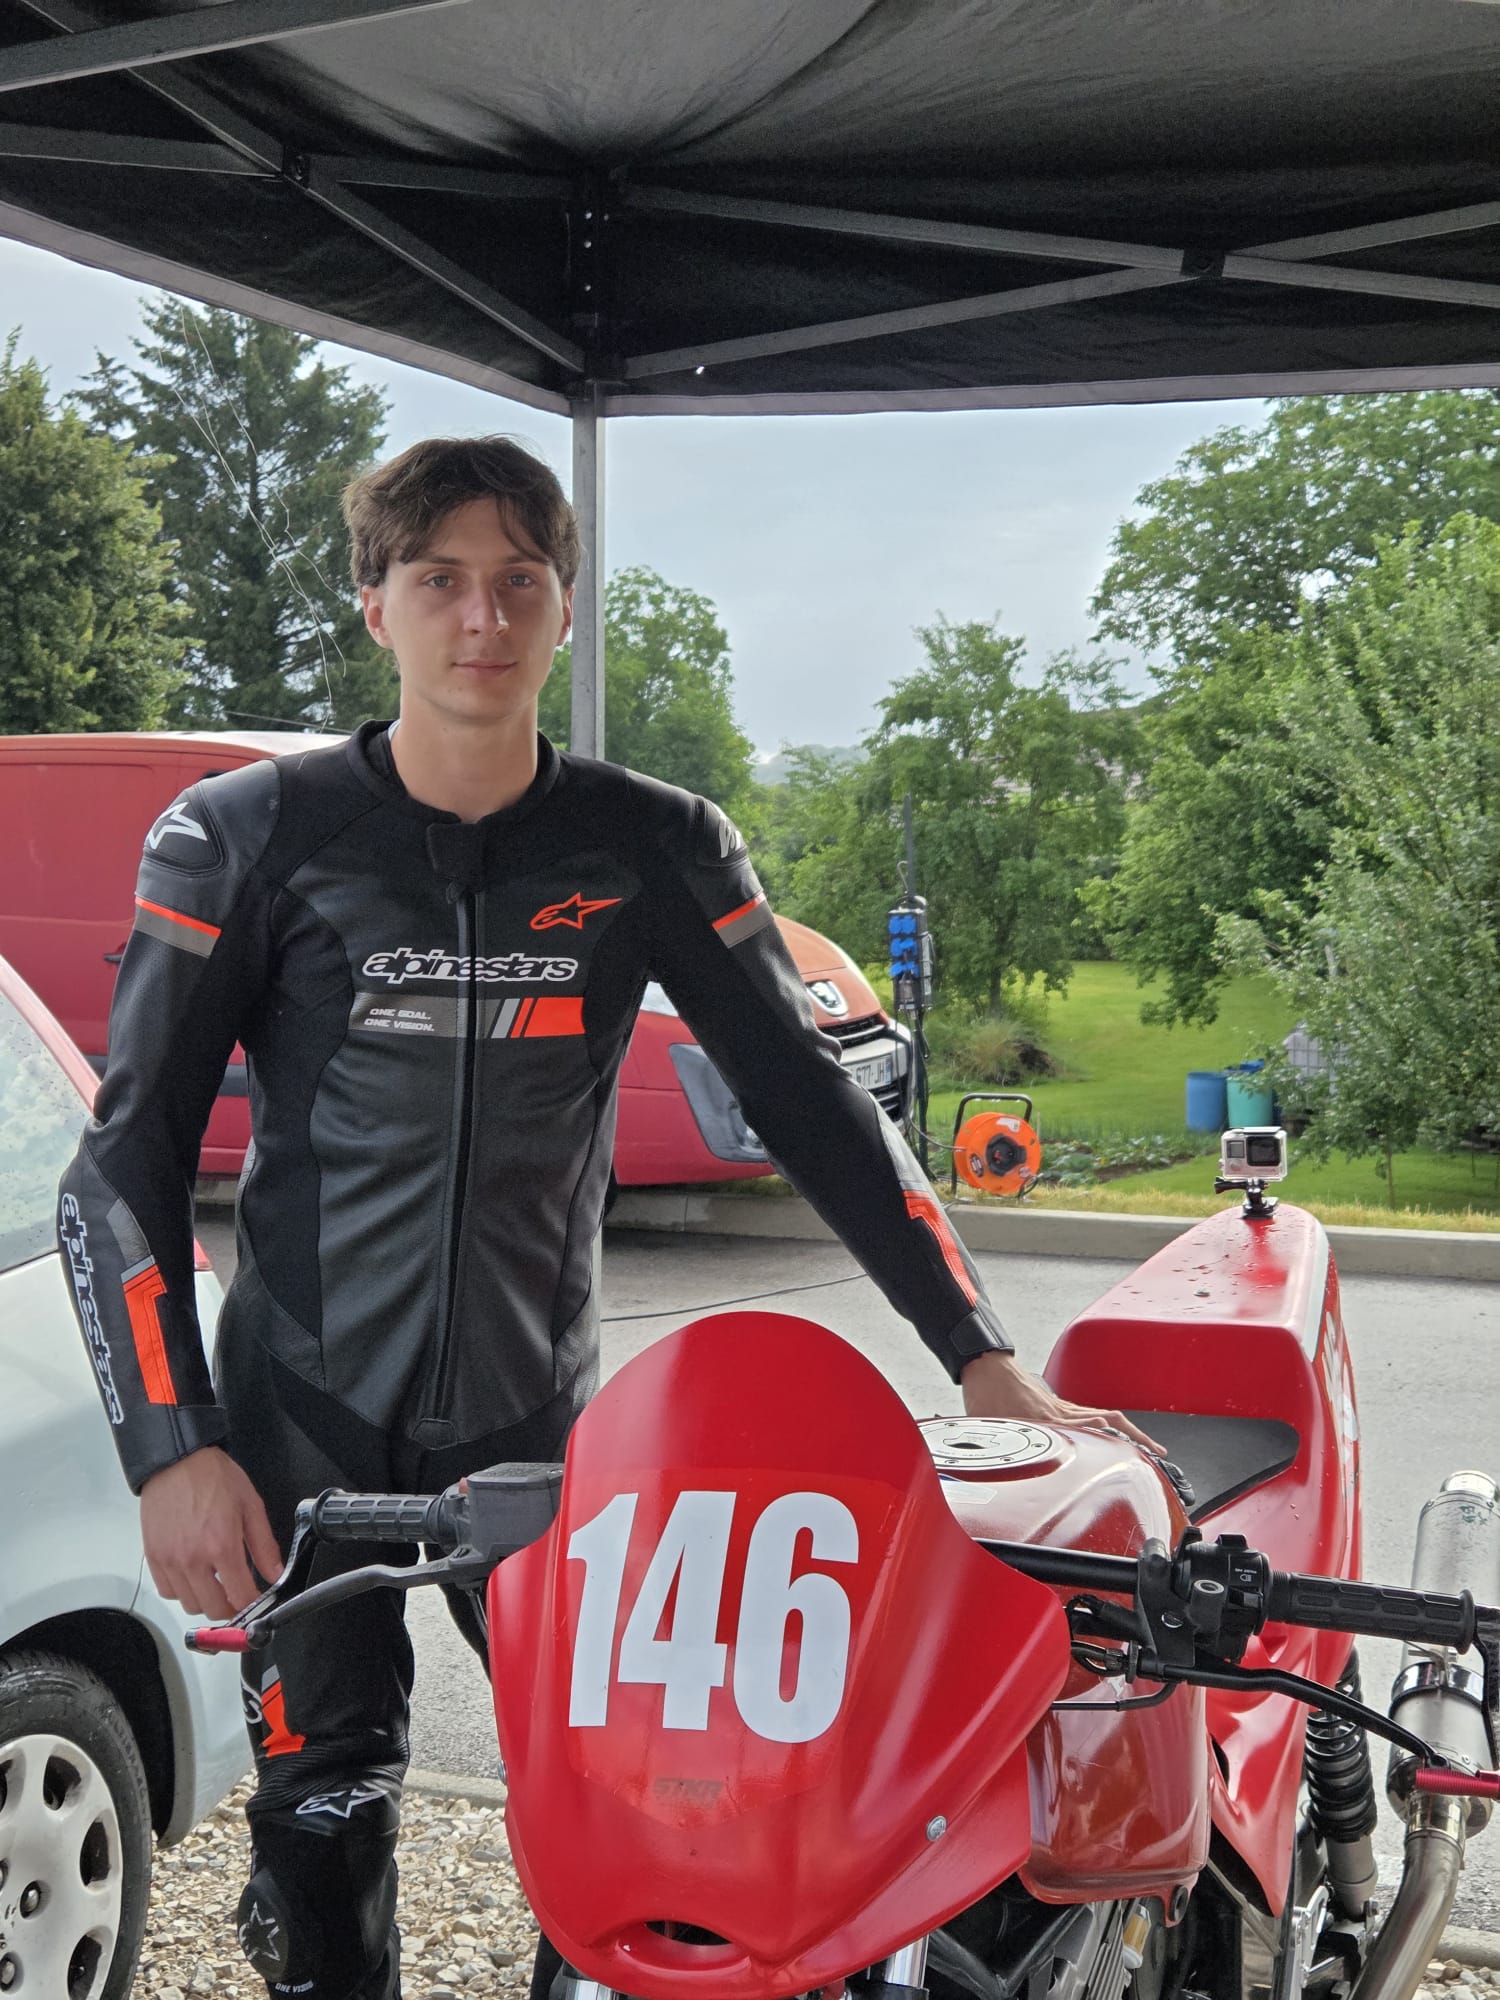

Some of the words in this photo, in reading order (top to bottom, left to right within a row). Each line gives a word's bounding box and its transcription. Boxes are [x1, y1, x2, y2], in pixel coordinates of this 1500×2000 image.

[362, 947, 578, 984] alpinestars
[364, 1018, 391, 1027] ONE
[393, 1020, 435, 1032] VISION.
[369, 1008, 396, 1017] ONE
[397, 1009, 431, 1020] GOAL.
[61, 1193, 124, 1424] alpinestars
[567, 1490, 859, 1743] 146
